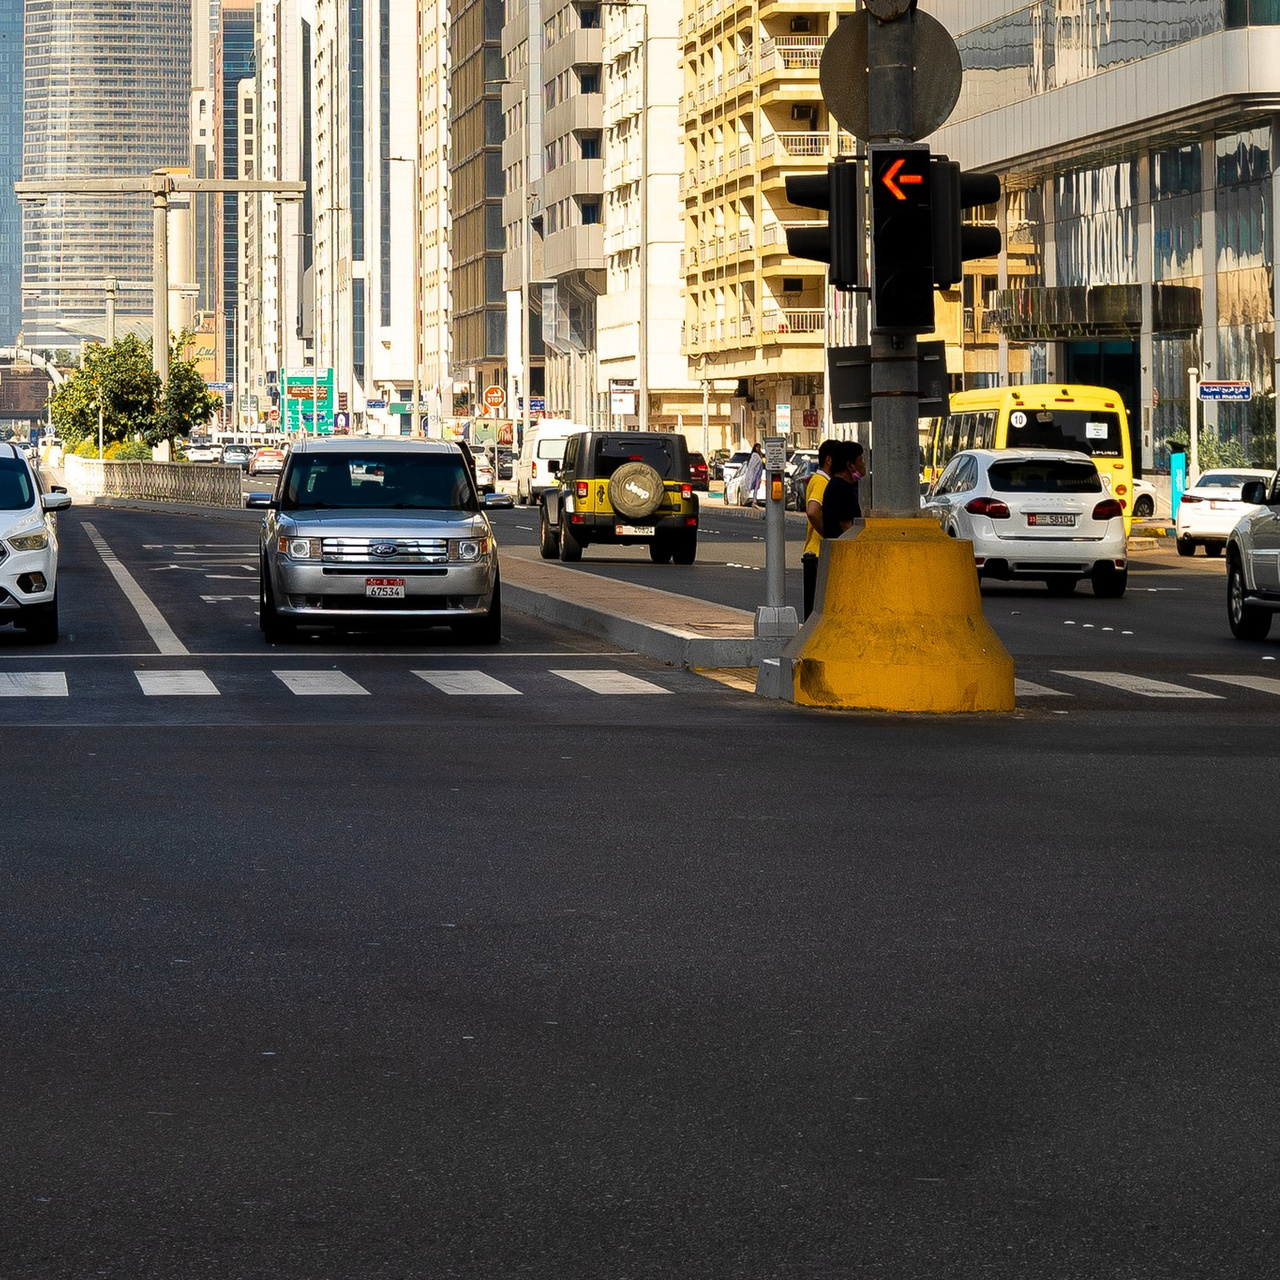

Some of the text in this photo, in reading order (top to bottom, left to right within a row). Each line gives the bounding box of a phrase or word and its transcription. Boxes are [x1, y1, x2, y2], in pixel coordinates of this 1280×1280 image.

[1014, 414, 1024, 425] 10
[625, 481, 650, 500] Jeep
[371, 587, 399, 596] 67534
